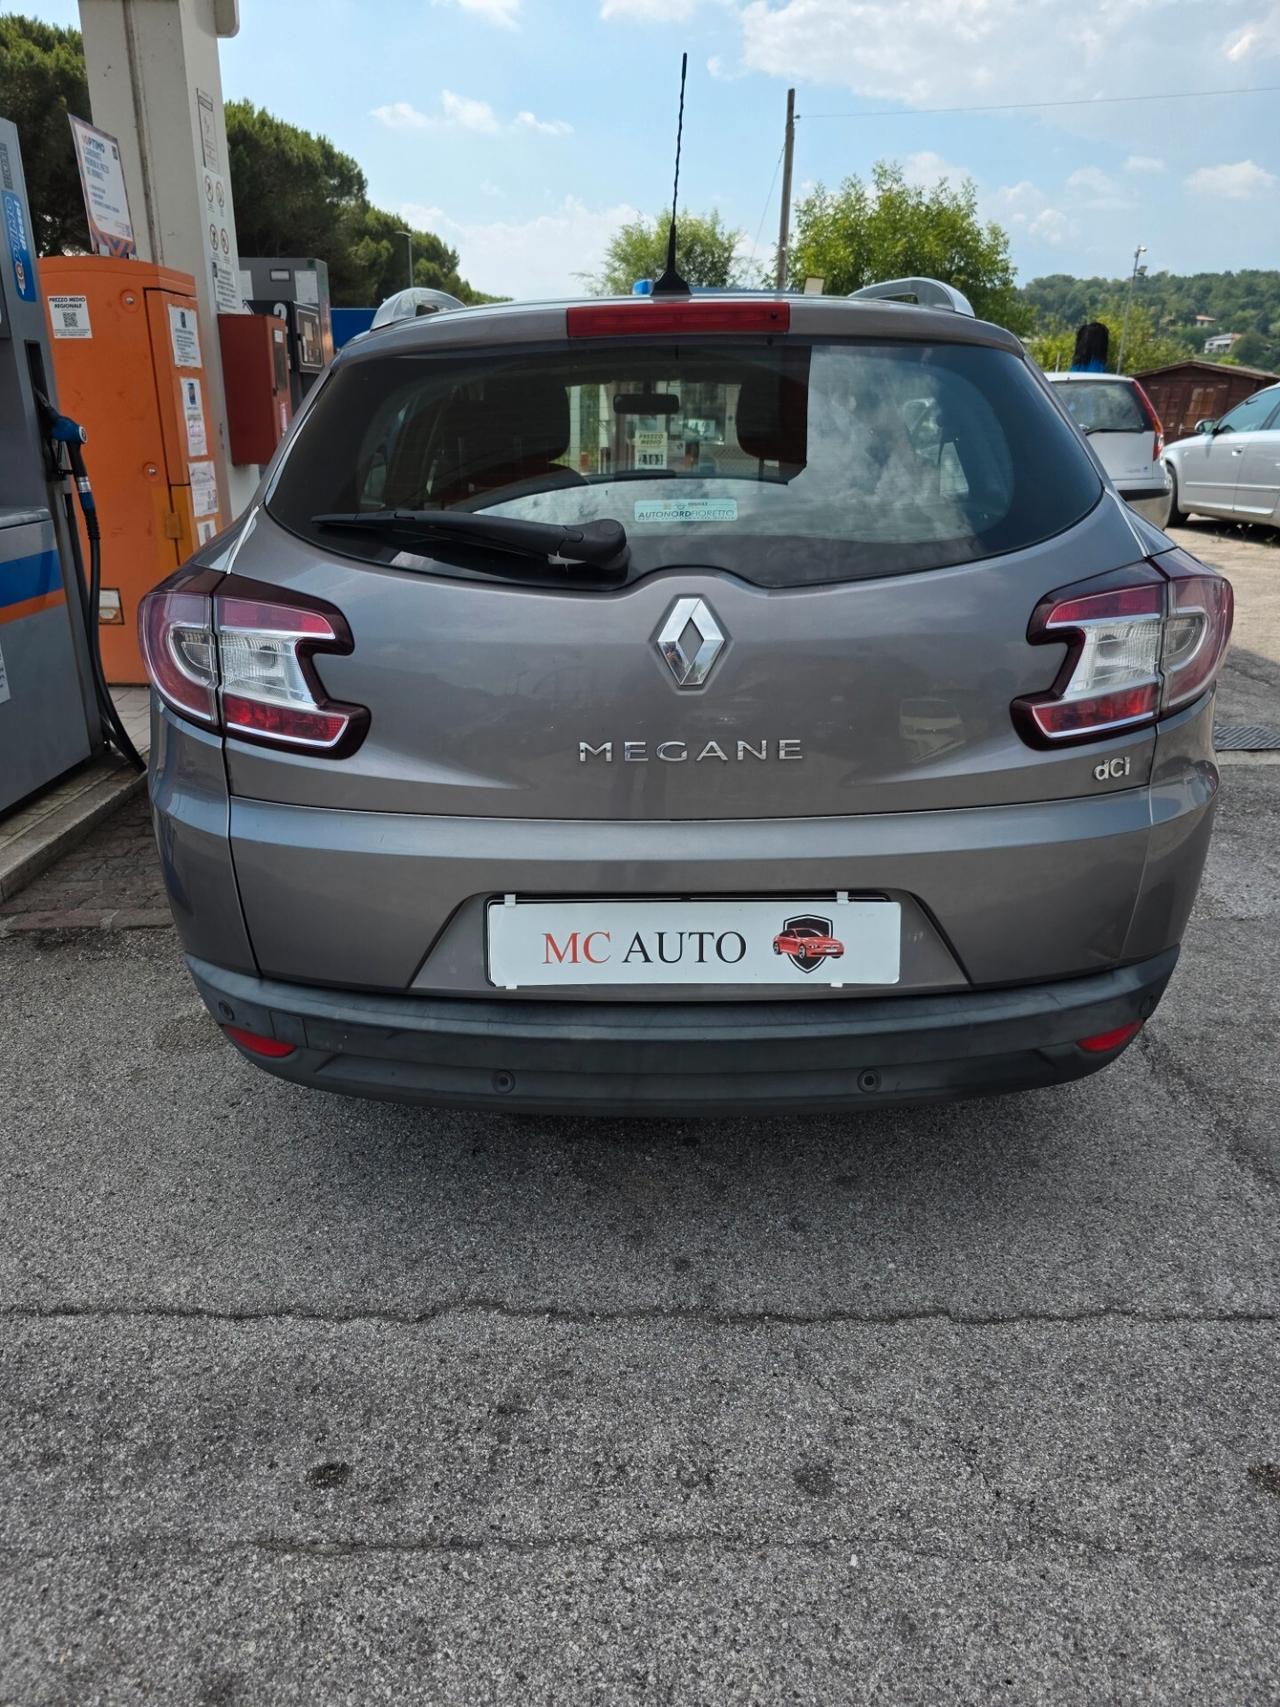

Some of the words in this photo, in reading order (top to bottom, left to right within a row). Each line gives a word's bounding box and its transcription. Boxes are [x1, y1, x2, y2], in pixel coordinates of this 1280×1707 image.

[13, 199, 26, 251] diesel
[579, 739, 803, 762] MEGANE
[543, 931, 611, 965] MC
[622, 930, 746, 965] AUTO
